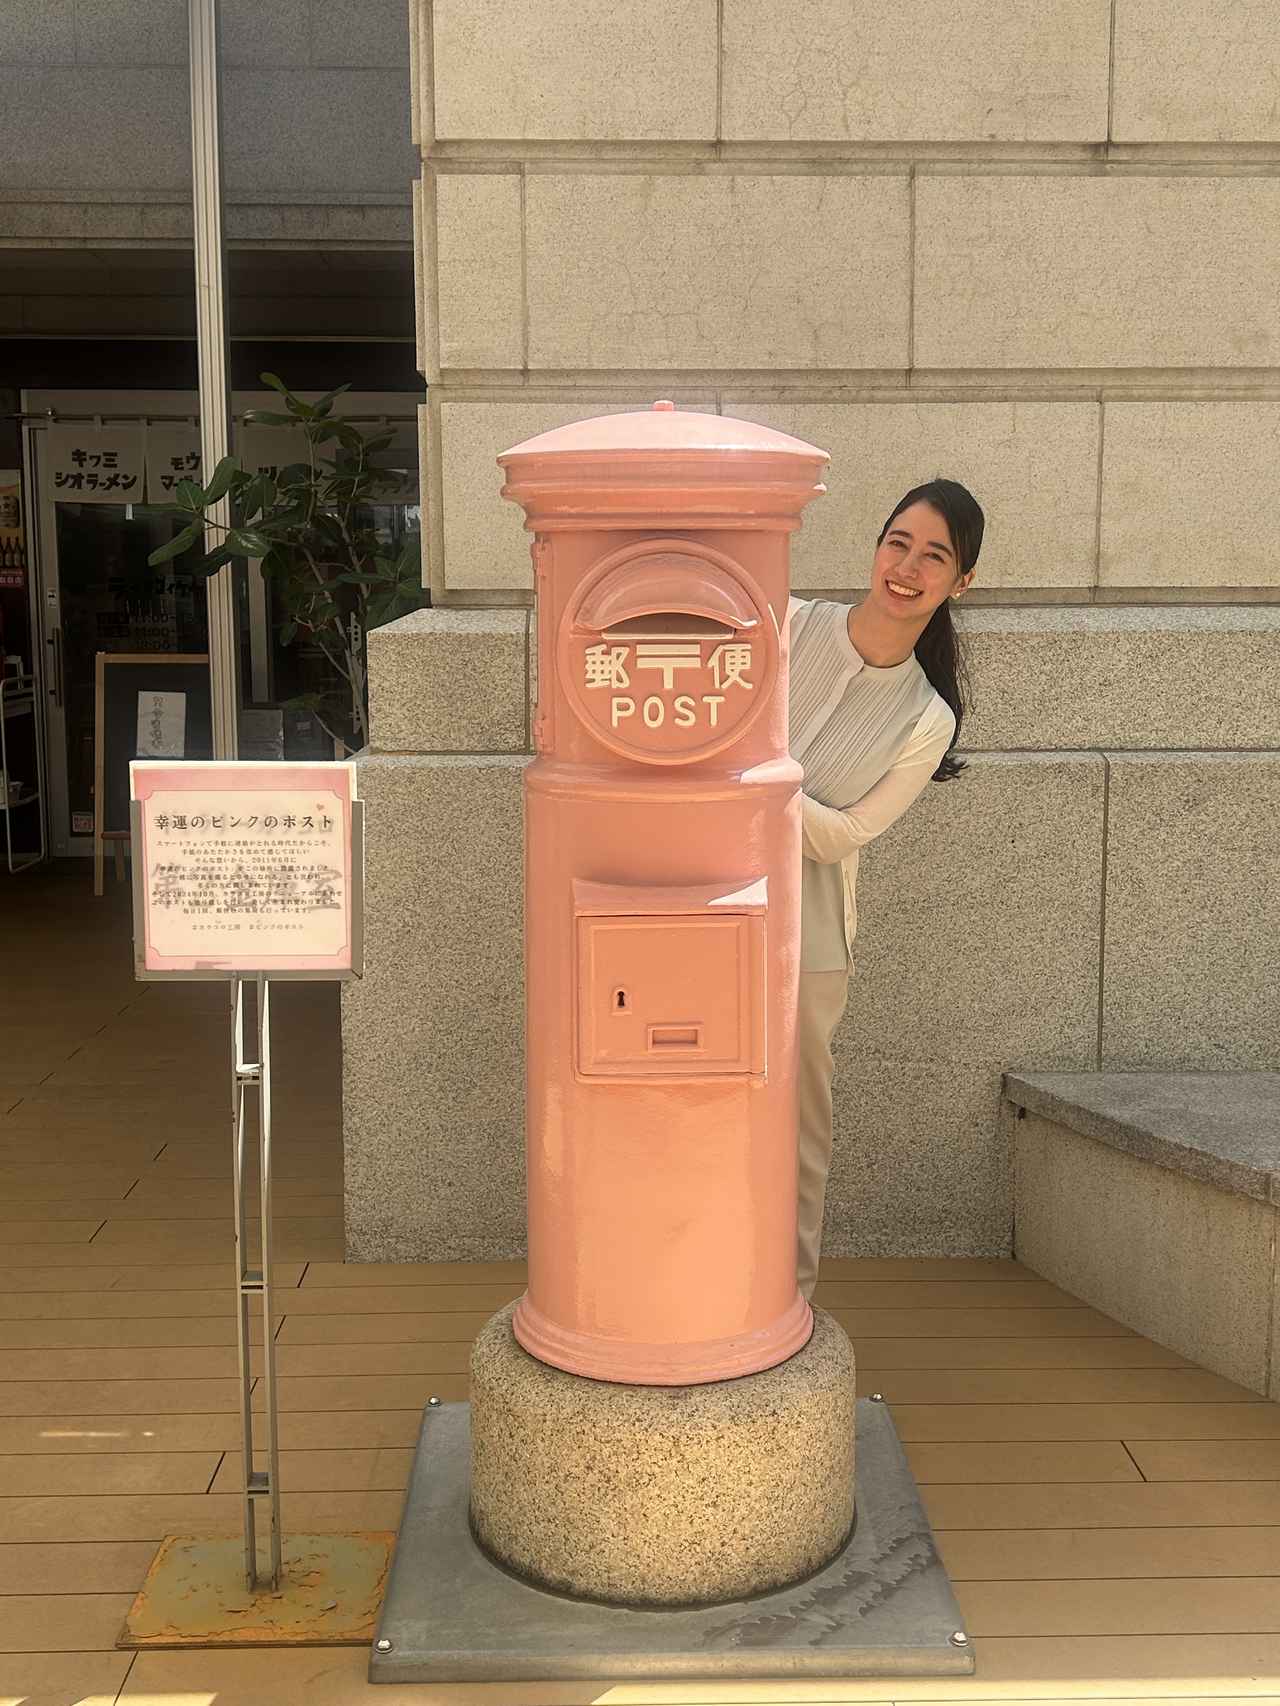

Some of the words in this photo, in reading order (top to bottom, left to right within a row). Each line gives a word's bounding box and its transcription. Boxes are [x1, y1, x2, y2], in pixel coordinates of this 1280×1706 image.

[72, 449, 118, 468] キワミ
[54, 472, 137, 490] シオラーメン
[612, 695, 726, 728] POST
[155, 815, 333, 829] 幸運のピンクのポスト
